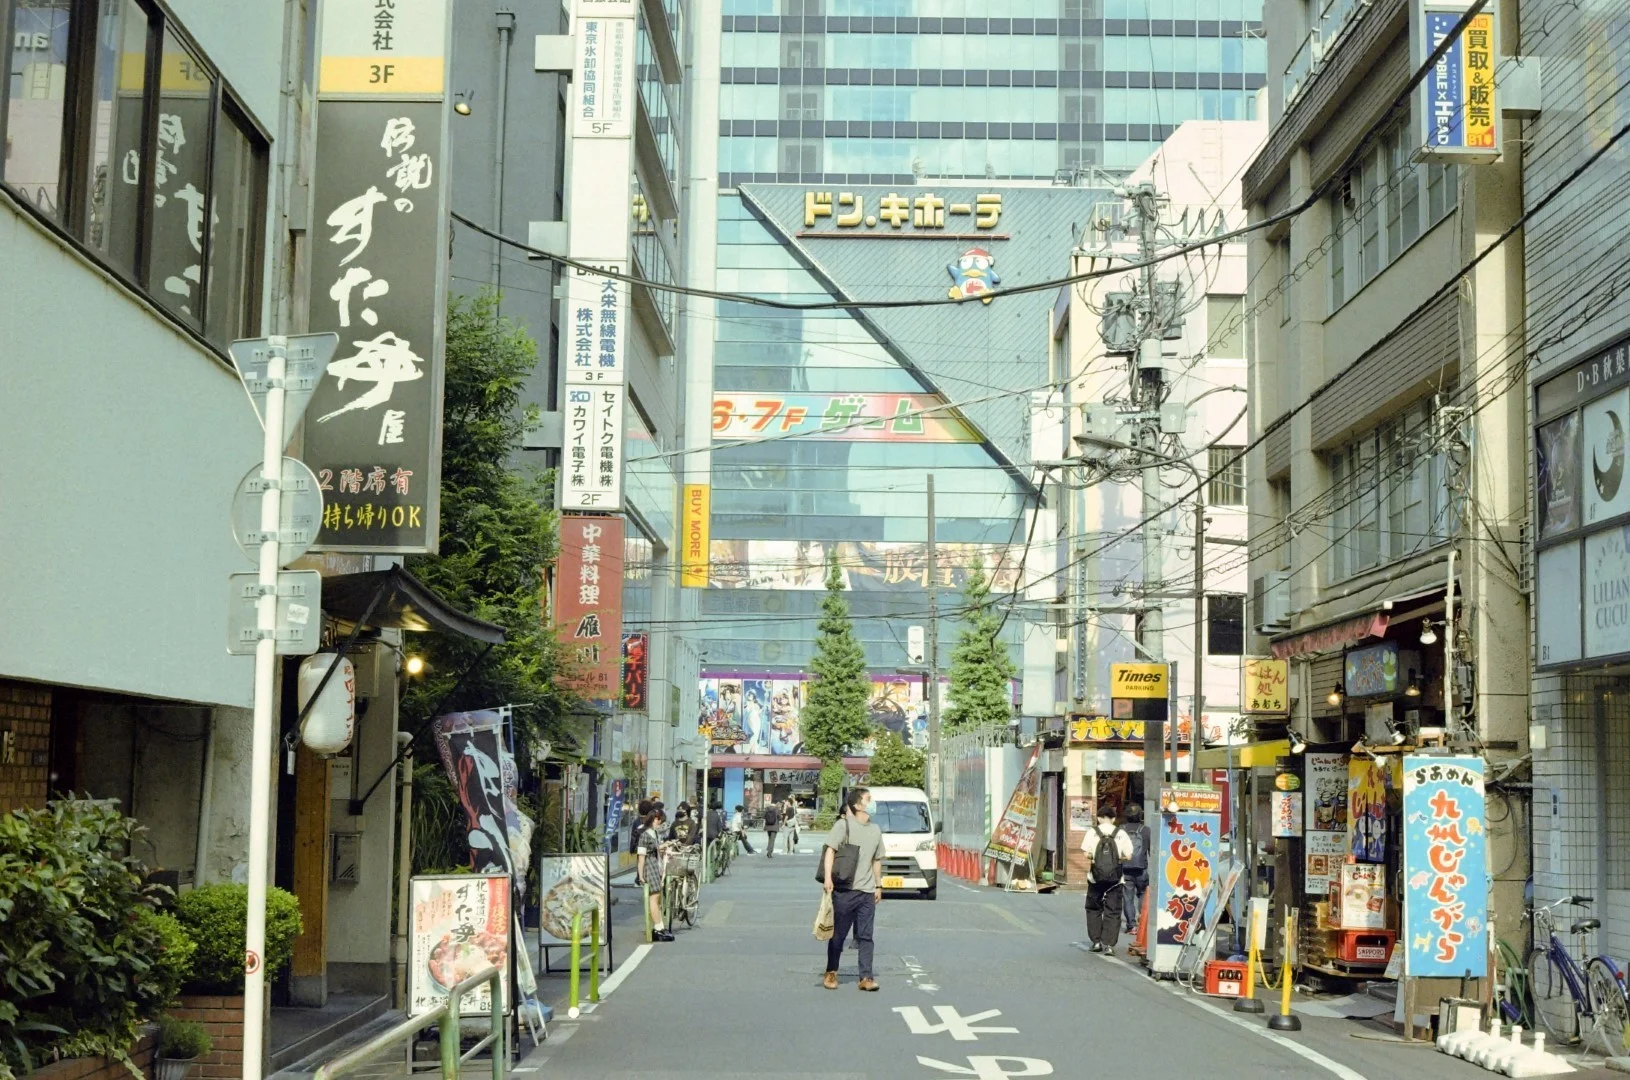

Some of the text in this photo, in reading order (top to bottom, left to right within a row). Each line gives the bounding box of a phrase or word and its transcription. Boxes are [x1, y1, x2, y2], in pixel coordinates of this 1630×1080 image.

[369, 64, 395, 83] 3F
[583, 21, 598, 118] 東京氷卸協同組合
[592, 122, 613, 134] 5F
[599, 279, 618, 367] 大栄無線電機
[574, 307, 593, 367] 株式会社
[820, 396, 926, 435] ゲーム
[319, 466, 413, 495] 2階席有
[580, 493, 602, 506] 2F
[689, 489, 702, 559] BUY MORE
[579, 523, 602, 606] 中華料理
[1117, 669, 1163, 683] Times
[1125, 684, 1155, 692] PARKING
[1415, 765, 1476, 786] らあめん
[1167, 816, 1212, 836] 九州
